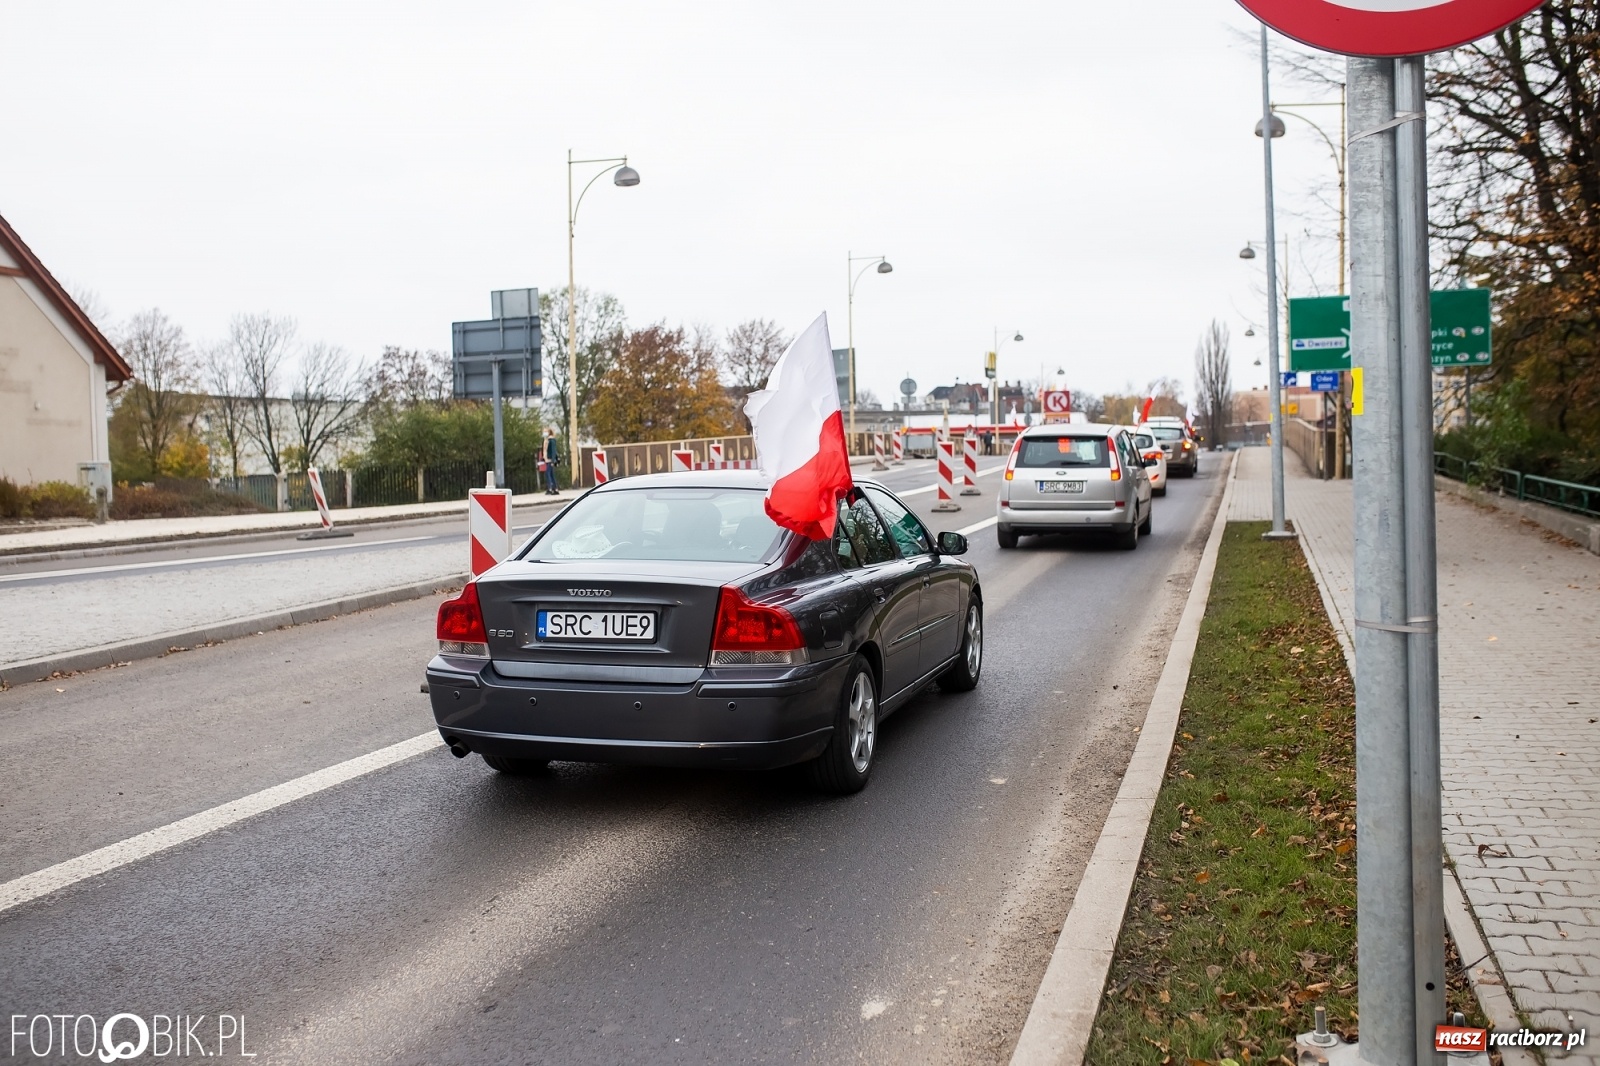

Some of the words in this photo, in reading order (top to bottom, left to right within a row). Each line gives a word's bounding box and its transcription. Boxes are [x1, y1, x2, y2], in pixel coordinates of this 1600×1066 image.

[1432, 327, 1447, 339] pki
[1308, 340, 1344, 348] Dworzec
[1432, 342, 1454, 352] zyce
[1432, 355, 1452, 365] zyn
[1045, 482, 1061, 490] SRC
[567, 588, 612, 597] VOLVO
[550, 614, 593, 636] SRC
[601, 614, 651, 637] 1UE9
[488, 629, 514, 638] S60
